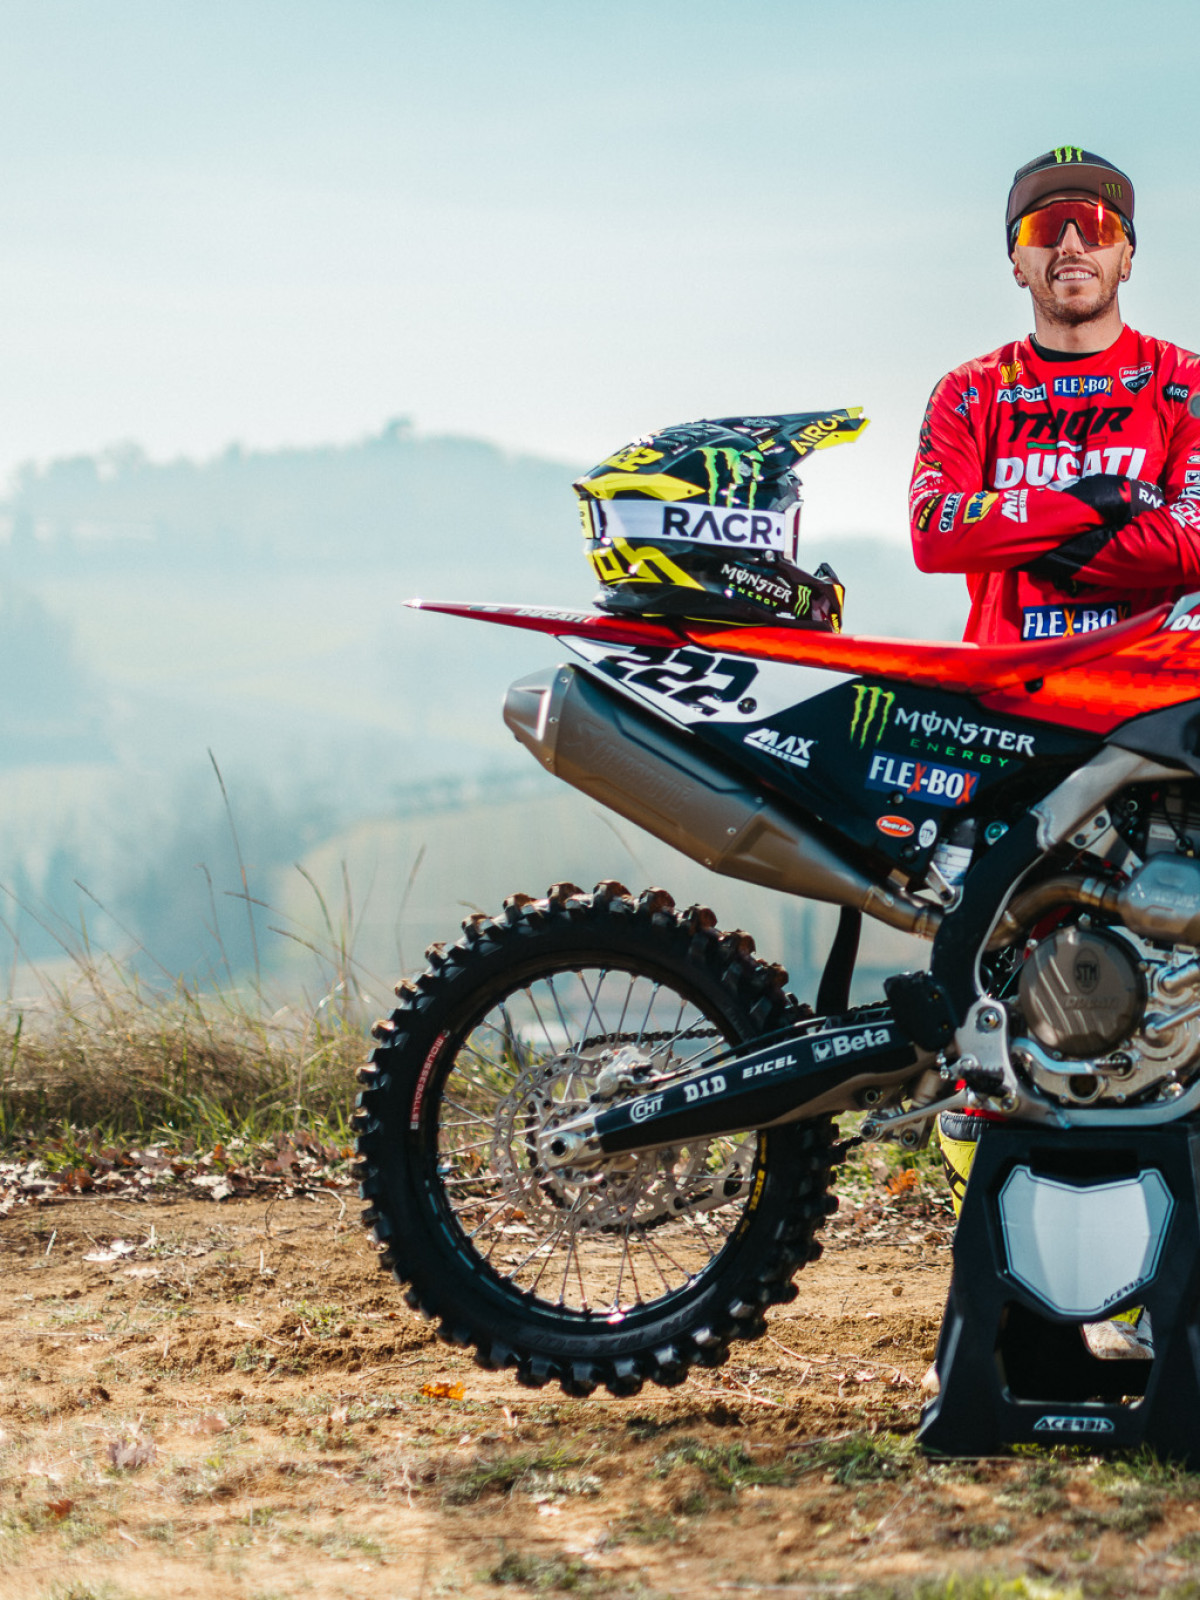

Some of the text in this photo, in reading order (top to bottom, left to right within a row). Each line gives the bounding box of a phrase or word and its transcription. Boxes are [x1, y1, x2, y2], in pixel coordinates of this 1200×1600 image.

[1053, 376, 1114, 396] FLEX-BOX
[1008, 406, 1134, 443] THOR
[993, 446, 1147, 491] DUCATI
[661, 505, 773, 546] RACR
[721, 563, 793, 604] MONSTER
[728, 583, 778, 607] ENERGY
[593, 646, 760, 717] 222
[747, 727, 815, 760] MAX
[894, 708, 1036, 757] MONSTER
[909, 738, 1010, 768] ENERGY
[868, 754, 978, 806] FLEX-BOX
[880, 819, 912, 833] Twin Air
[832, 1028, 891, 1057] Beta
[742, 1054, 798, 1080] EXCEL
